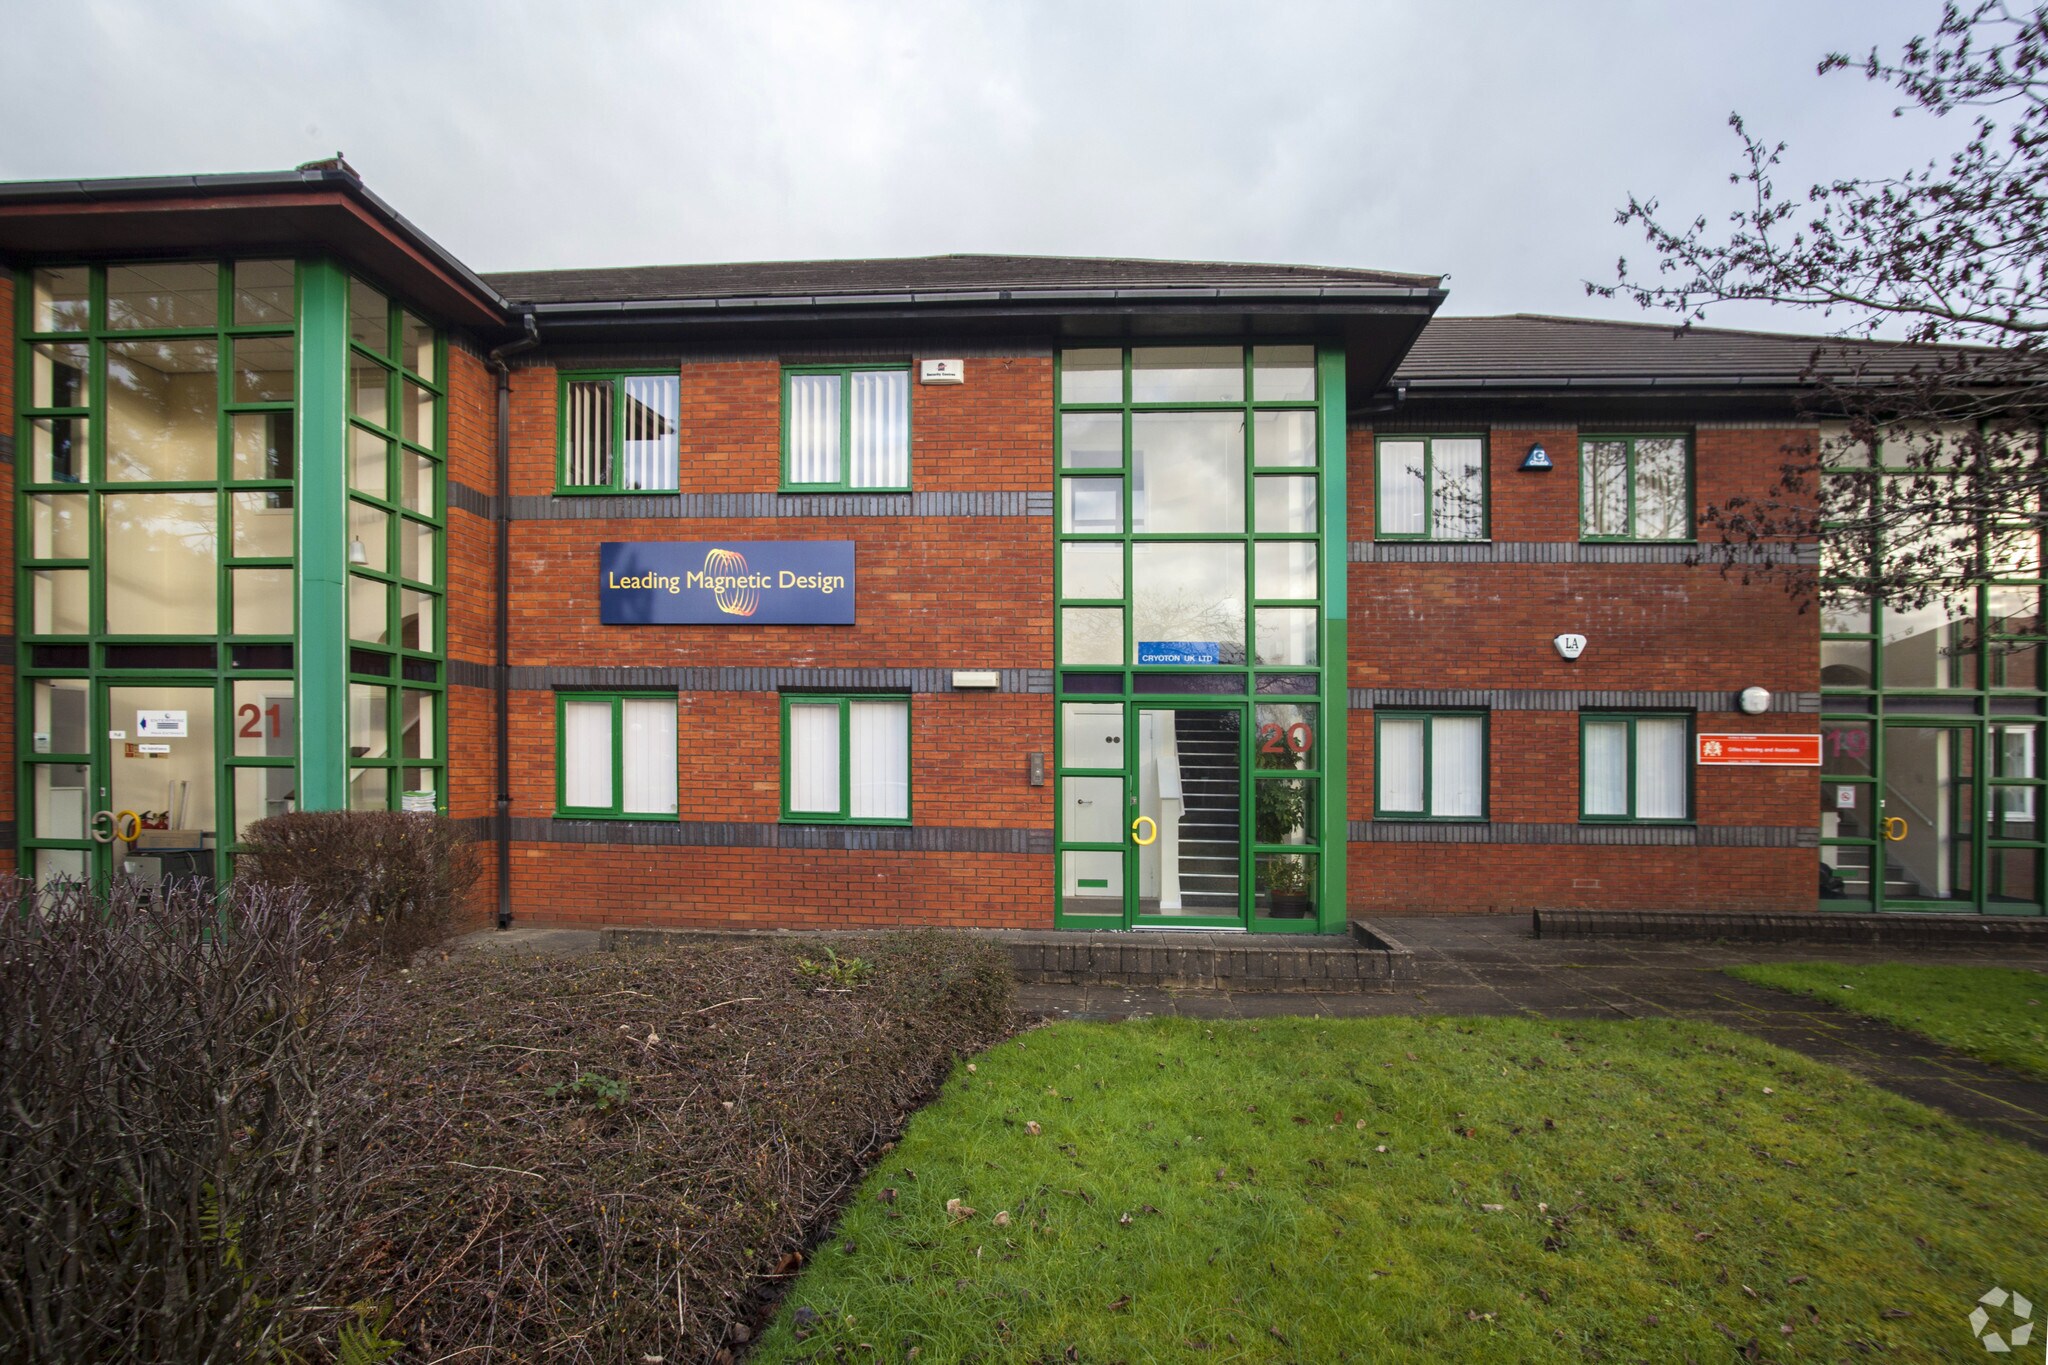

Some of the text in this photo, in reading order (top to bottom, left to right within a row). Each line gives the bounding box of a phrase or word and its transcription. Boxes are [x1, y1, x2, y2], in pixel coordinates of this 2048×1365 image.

[608, 571, 845, 594] Leading Magnetic Design
[1565, 637, 1579, 649] LA
[1142, 654, 1213, 662] CRYOTON UK LTD
[238, 703, 281, 739] 21
[1261, 722, 1313, 754] 20
[1826, 728, 1868, 758] 19
